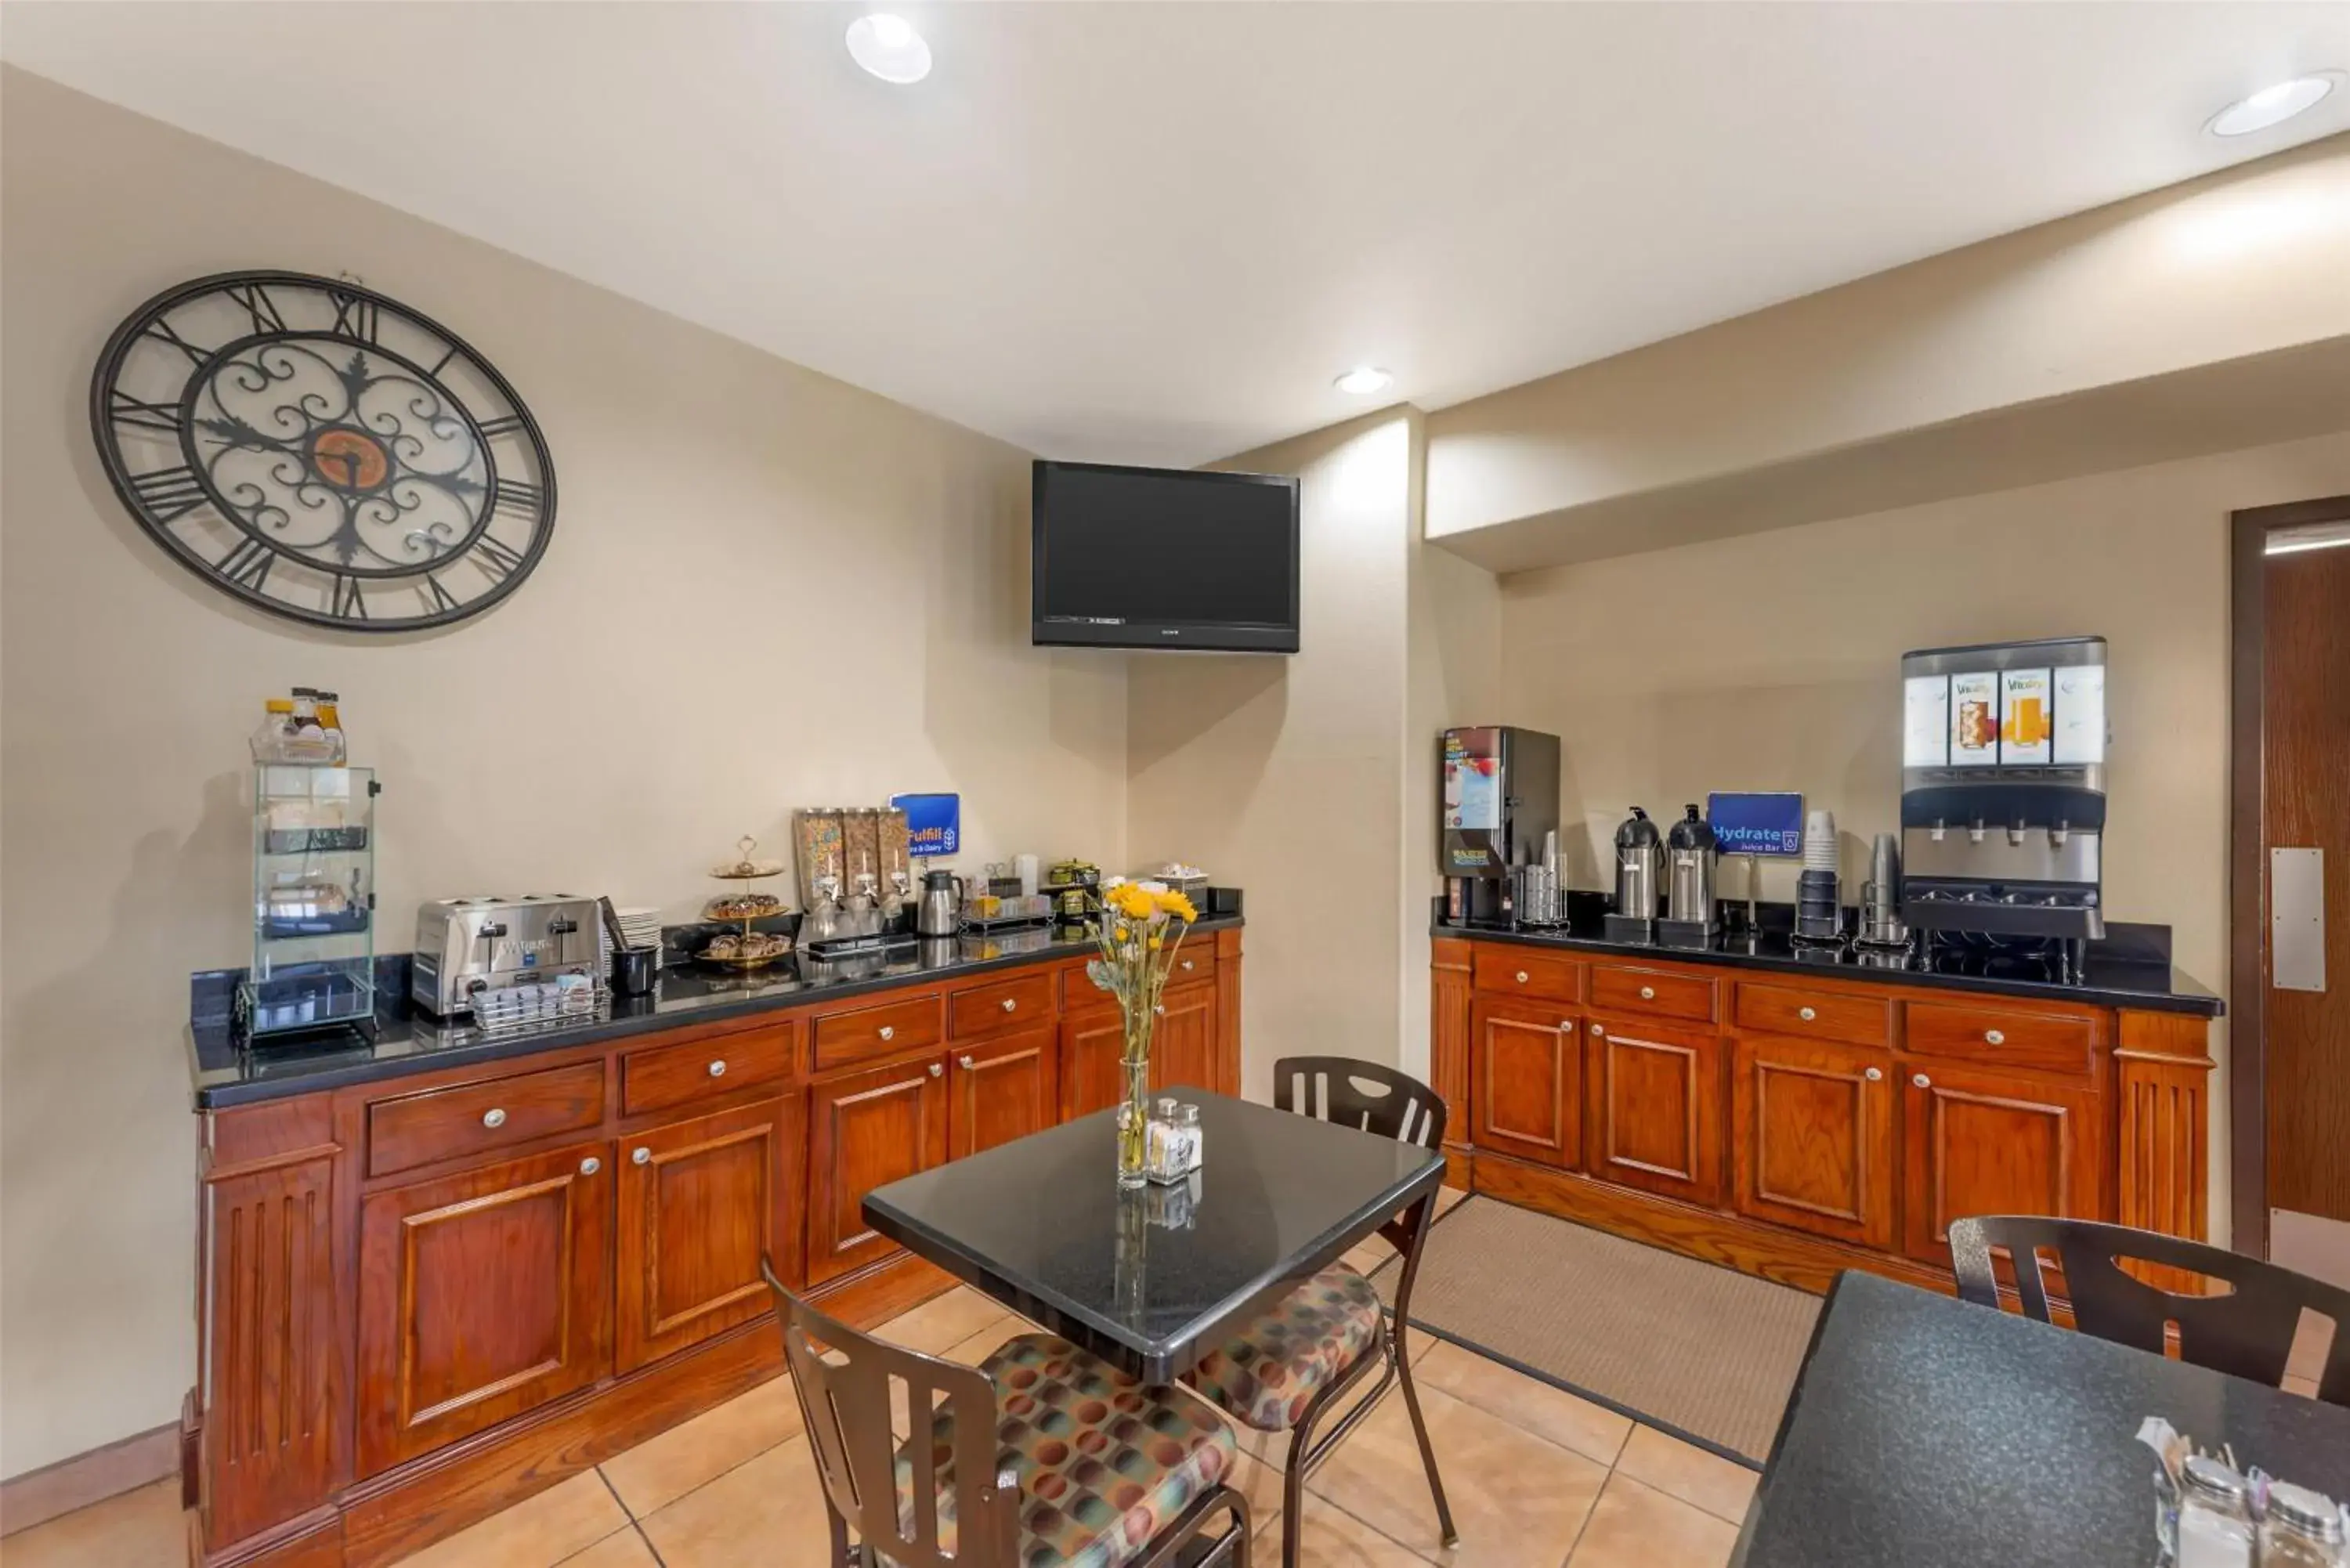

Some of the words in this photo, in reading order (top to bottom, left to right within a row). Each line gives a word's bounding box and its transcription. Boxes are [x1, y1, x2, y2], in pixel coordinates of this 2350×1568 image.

[143, 316, 215, 368] X
[326, 291, 378, 349] XII
[1713, 826, 1781, 842] Hydrate
